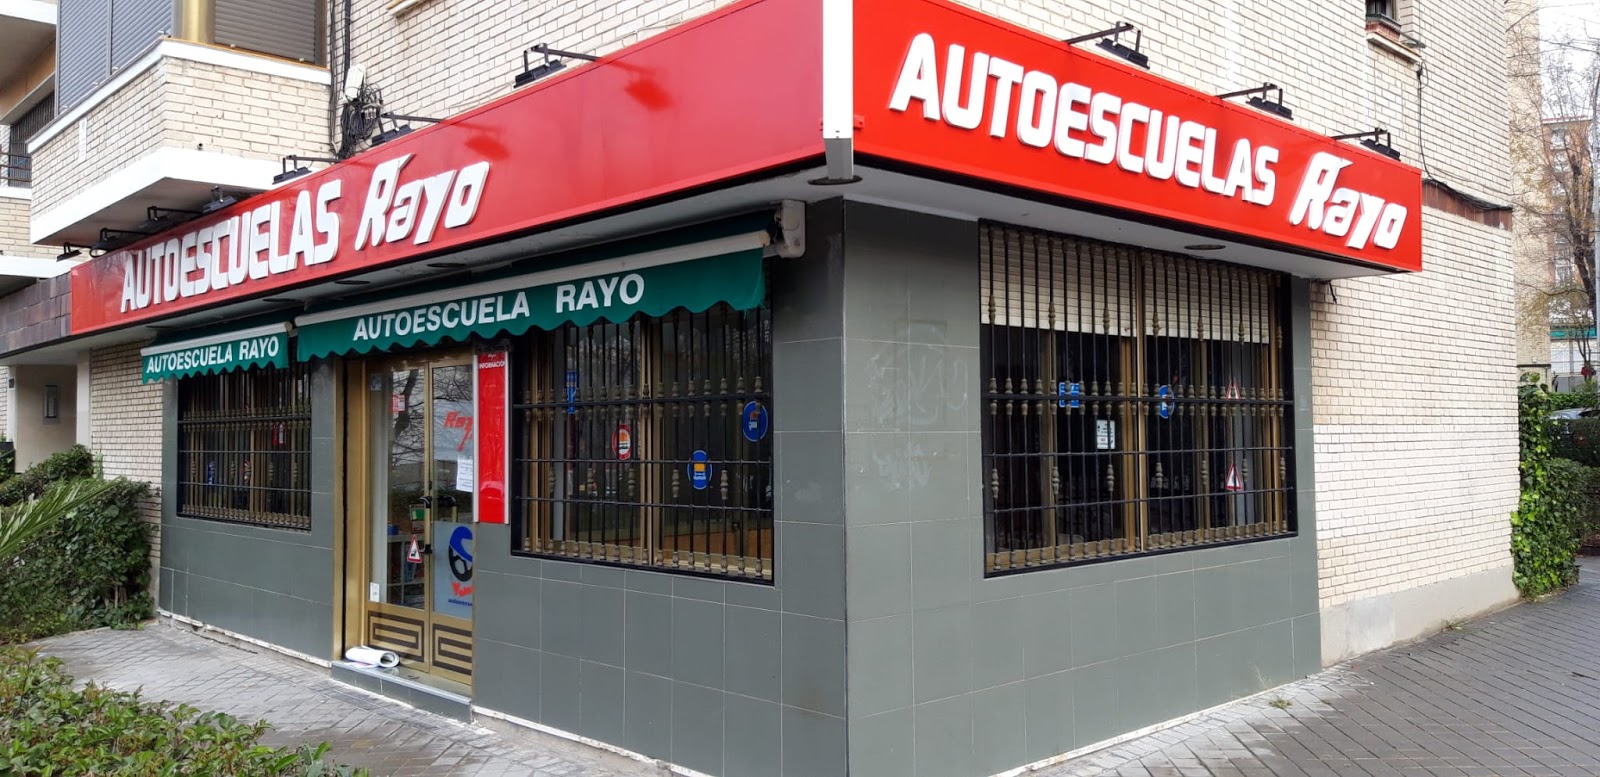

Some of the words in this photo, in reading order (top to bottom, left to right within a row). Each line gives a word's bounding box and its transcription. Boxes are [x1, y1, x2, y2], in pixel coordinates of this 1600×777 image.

[888, 32, 1279, 207] AUTOESCUELAS
[1289, 151, 1408, 250] Rayo
[120, 179, 341, 313] AUTOESCUELAS
[354, 153, 490, 250] Rayo
[146, 344, 232, 373] AUTOESCUELA
[239, 336, 279, 360] RAYO
[353, 289, 530, 341] AUTOESCUELA
[556, 273, 645, 313] RAYO
